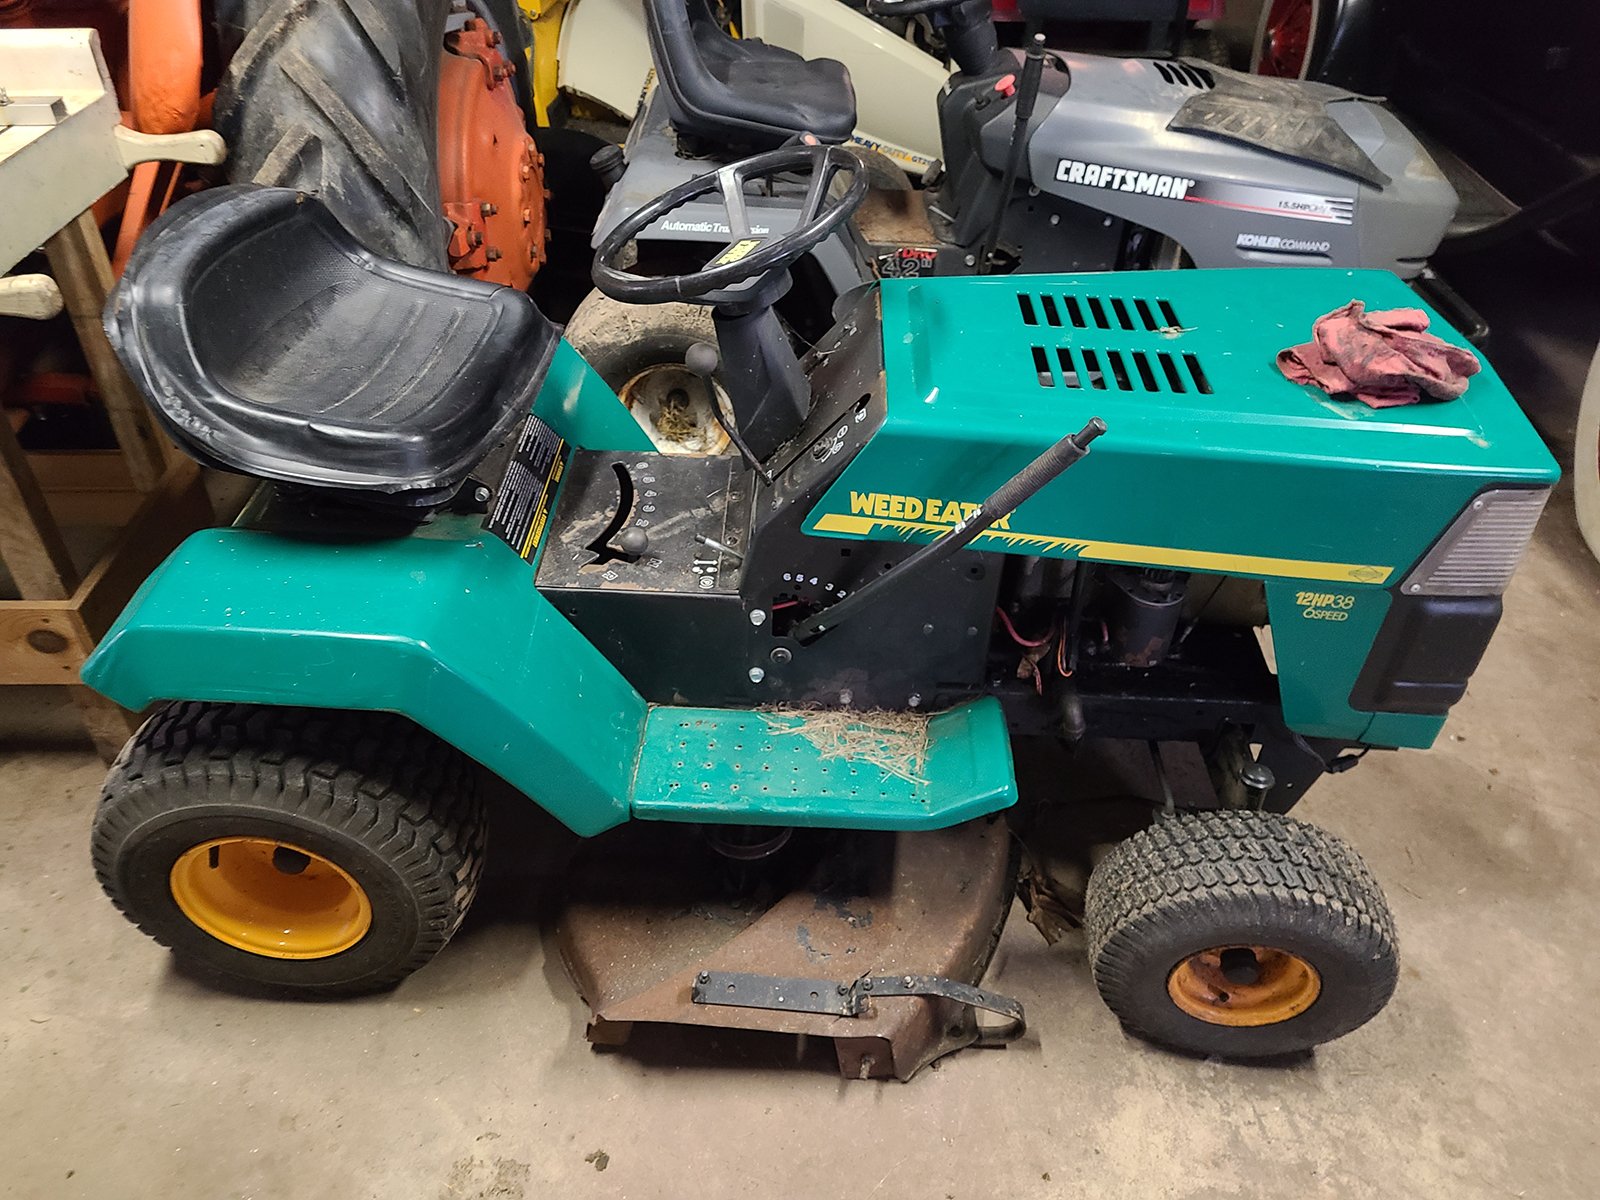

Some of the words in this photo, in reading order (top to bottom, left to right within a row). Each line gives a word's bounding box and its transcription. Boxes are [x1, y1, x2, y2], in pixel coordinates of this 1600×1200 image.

[1056, 159, 1189, 200] CRAFTSMAN
[661, 220, 713, 233] Automatic
[1236, 233, 1281, 248] KOHLER
[850, 491, 923, 520] WEED
[925, 498, 1011, 530] EATR
